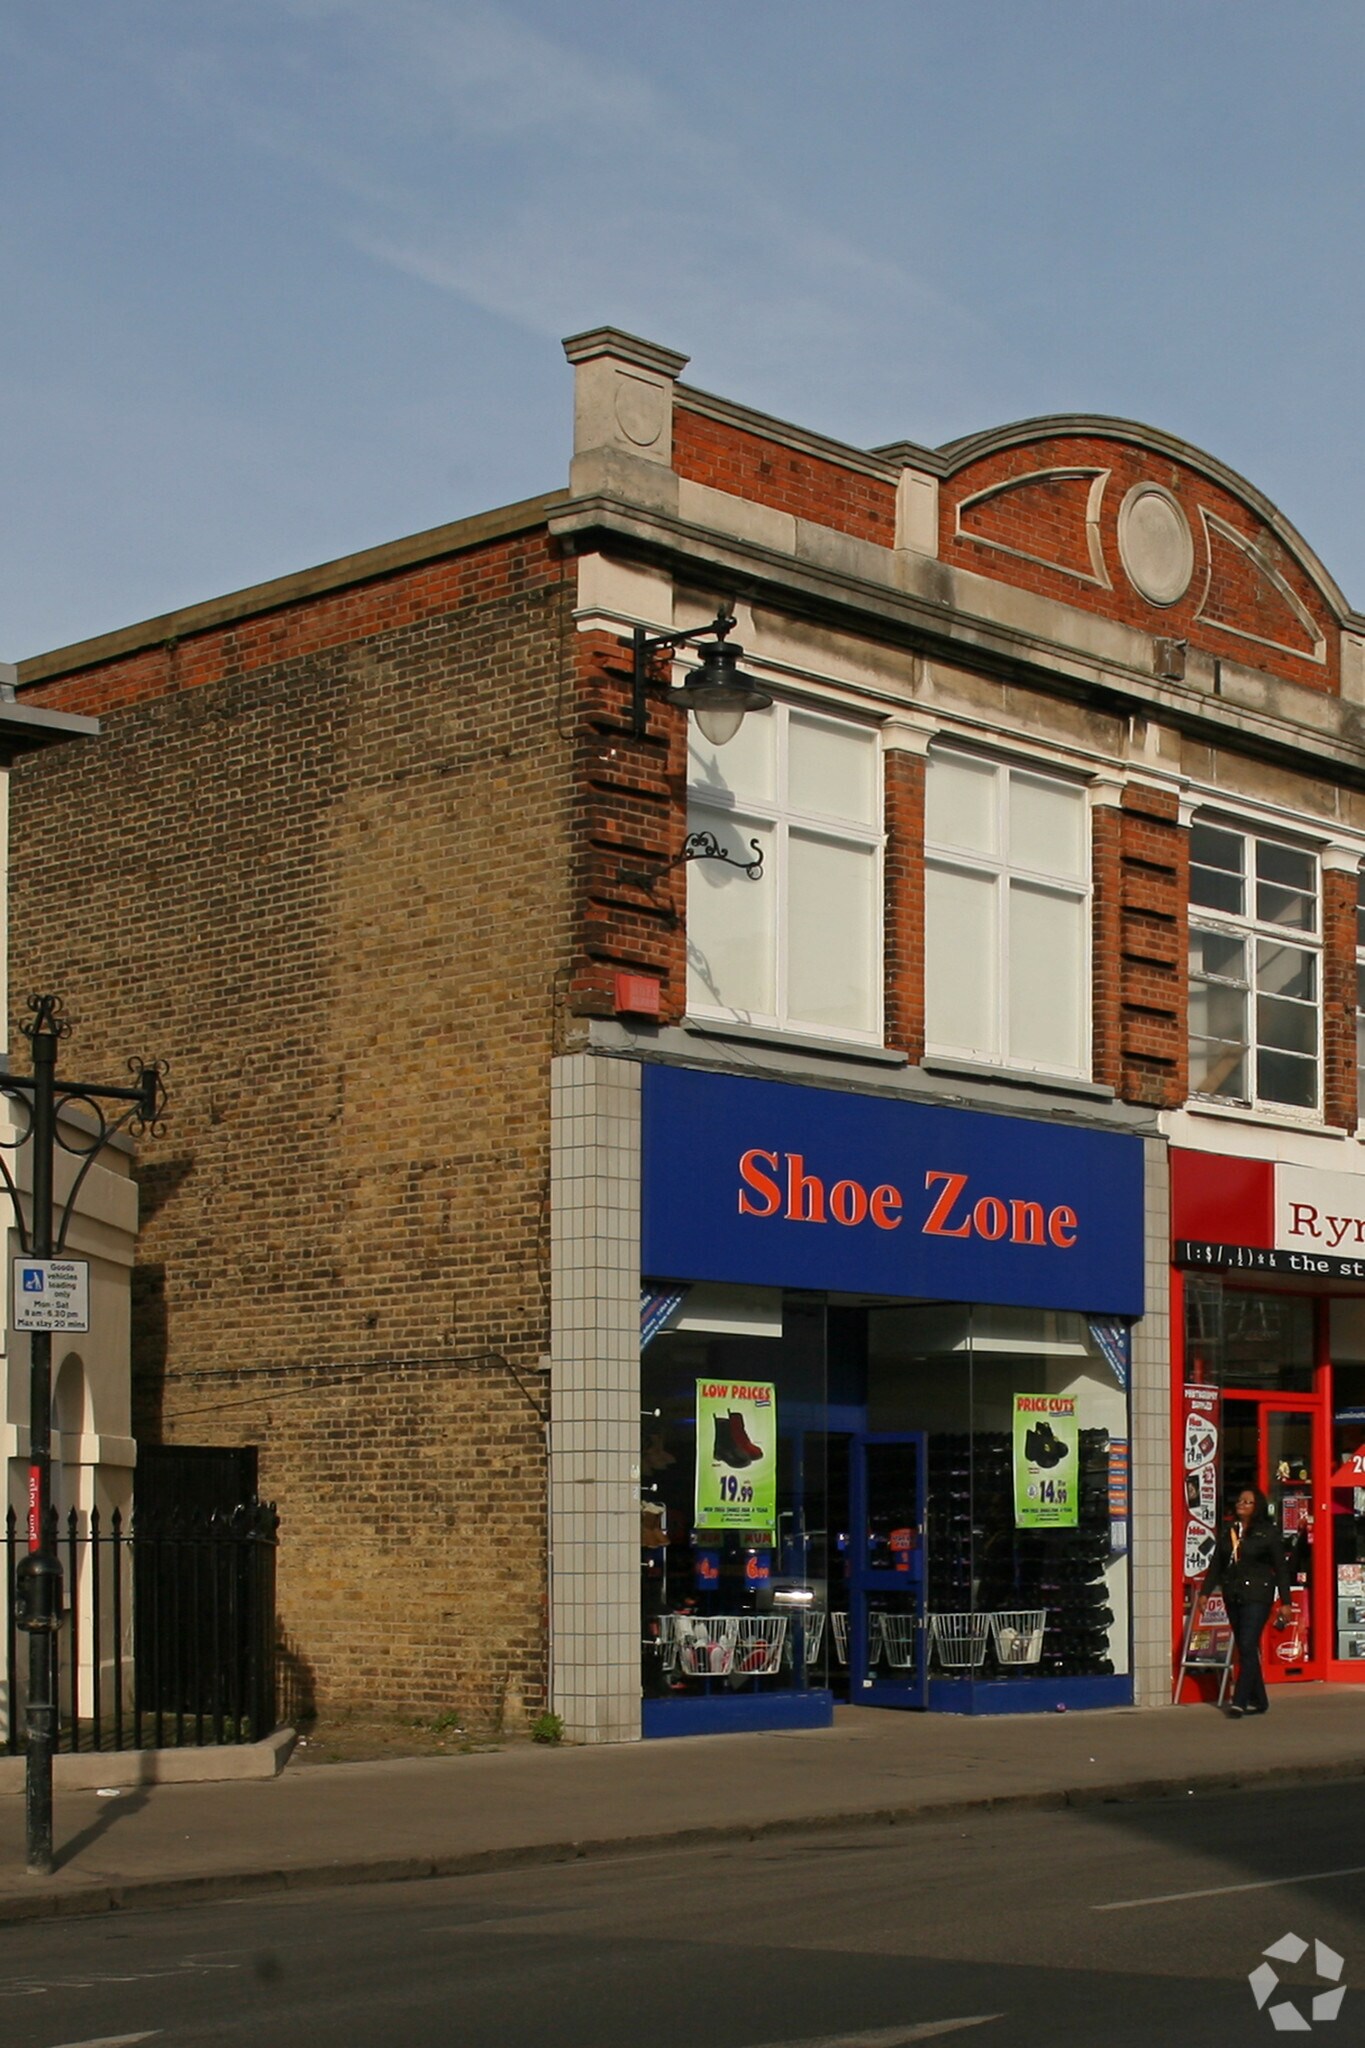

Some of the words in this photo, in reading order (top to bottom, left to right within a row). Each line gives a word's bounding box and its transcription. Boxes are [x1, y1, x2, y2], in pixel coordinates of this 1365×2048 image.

[738, 1149, 903, 1230] Shoe
[921, 1170, 1079, 1249] Zone
[50, 1263, 75, 1272] Goods
[1289, 1255, 1330, 1273] the
[47, 1273, 78, 1281] vehicles
[48, 1282, 77, 1290] loading
[54, 1291, 71, 1299] only
[33, 1300, 51, 1308] Mon
[55, 1301, 69, 1309] Sat
[17, 1319, 34, 1327] Max
[36, 1320, 52, 1328] stay
[54, 1320, 66, 1328] 20
[702, 1384, 728, 1398] LOW
[731, 1386, 771, 1401] PRICES
[1017, 1397, 1047, 1412] PRICE
[1049, 1397, 1075, 1412] CUTS
[720, 1475, 754, 1503] 19.99
[1040, 1480, 1067, 1504] 14.99
